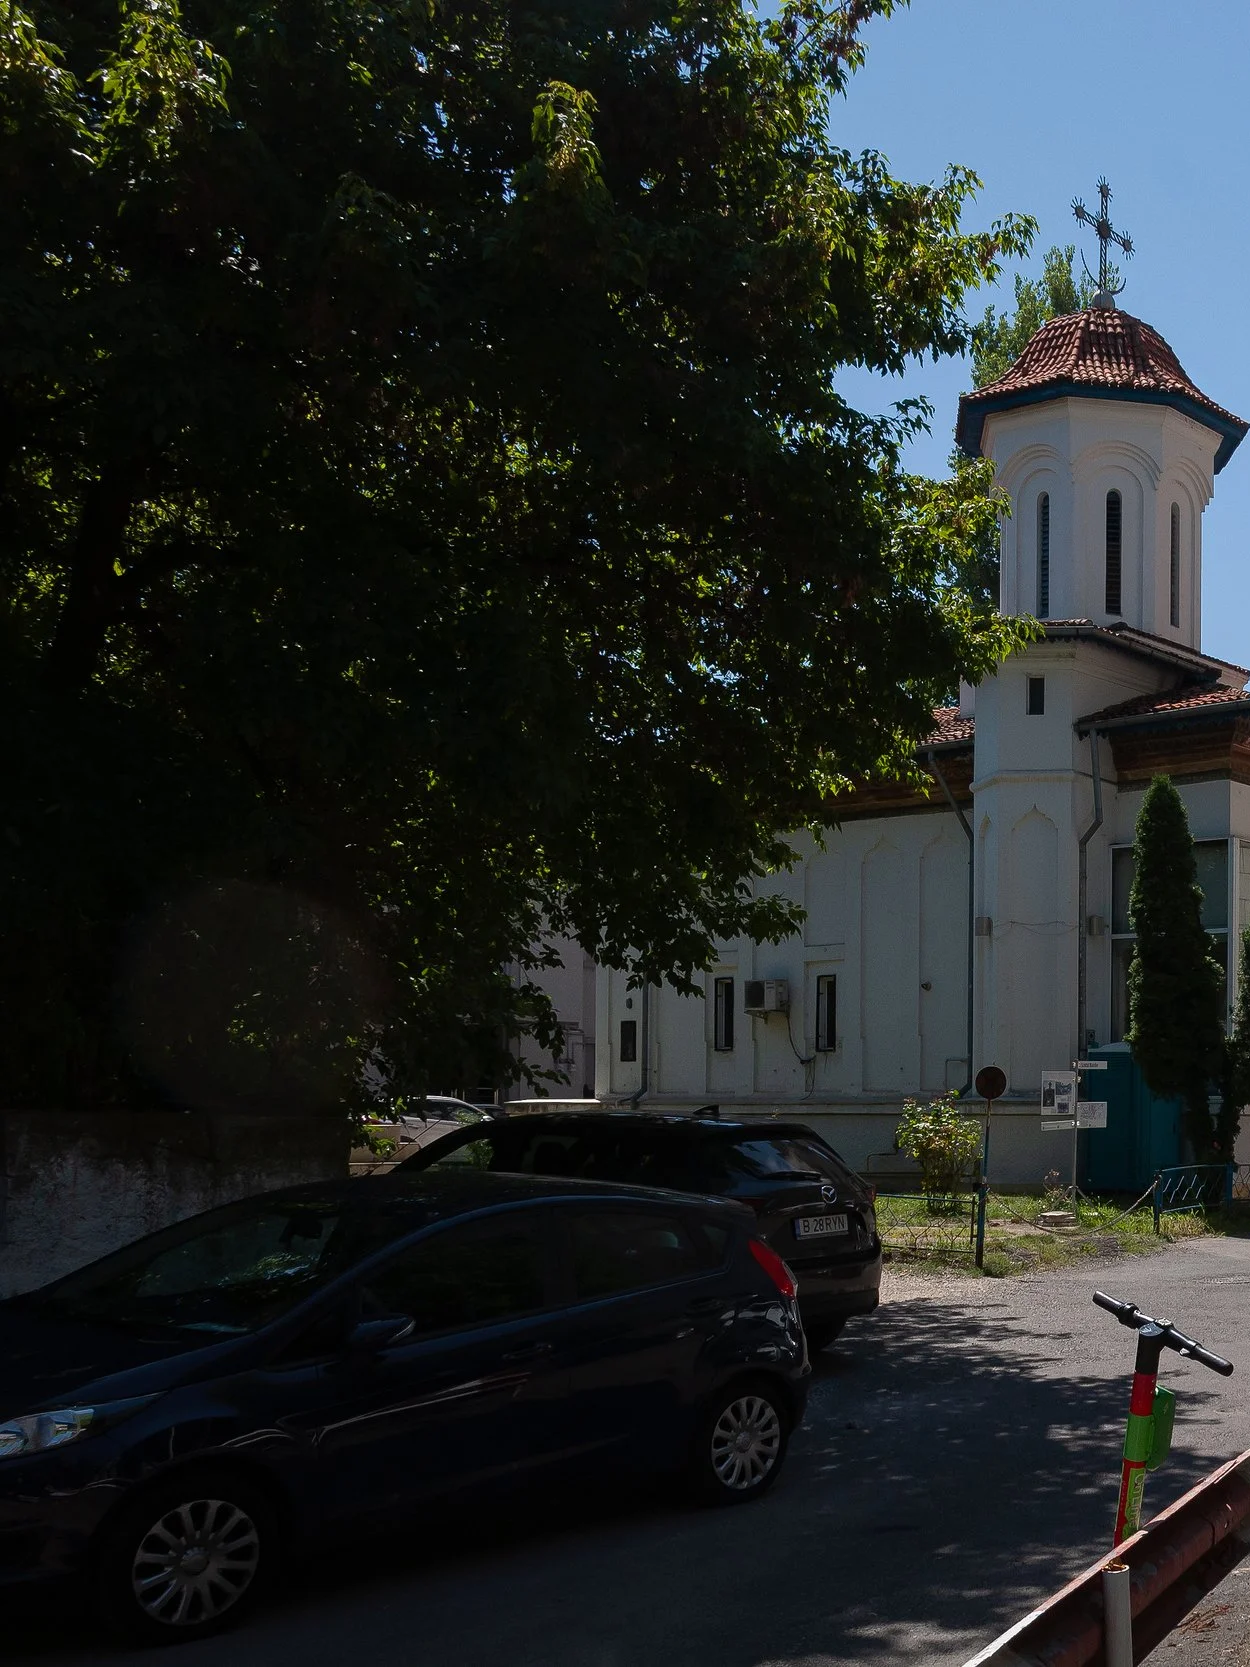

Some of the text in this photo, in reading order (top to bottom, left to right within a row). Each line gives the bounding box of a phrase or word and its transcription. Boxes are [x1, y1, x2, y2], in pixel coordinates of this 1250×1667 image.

[803, 1215, 845, 1233] B 28 RYN
